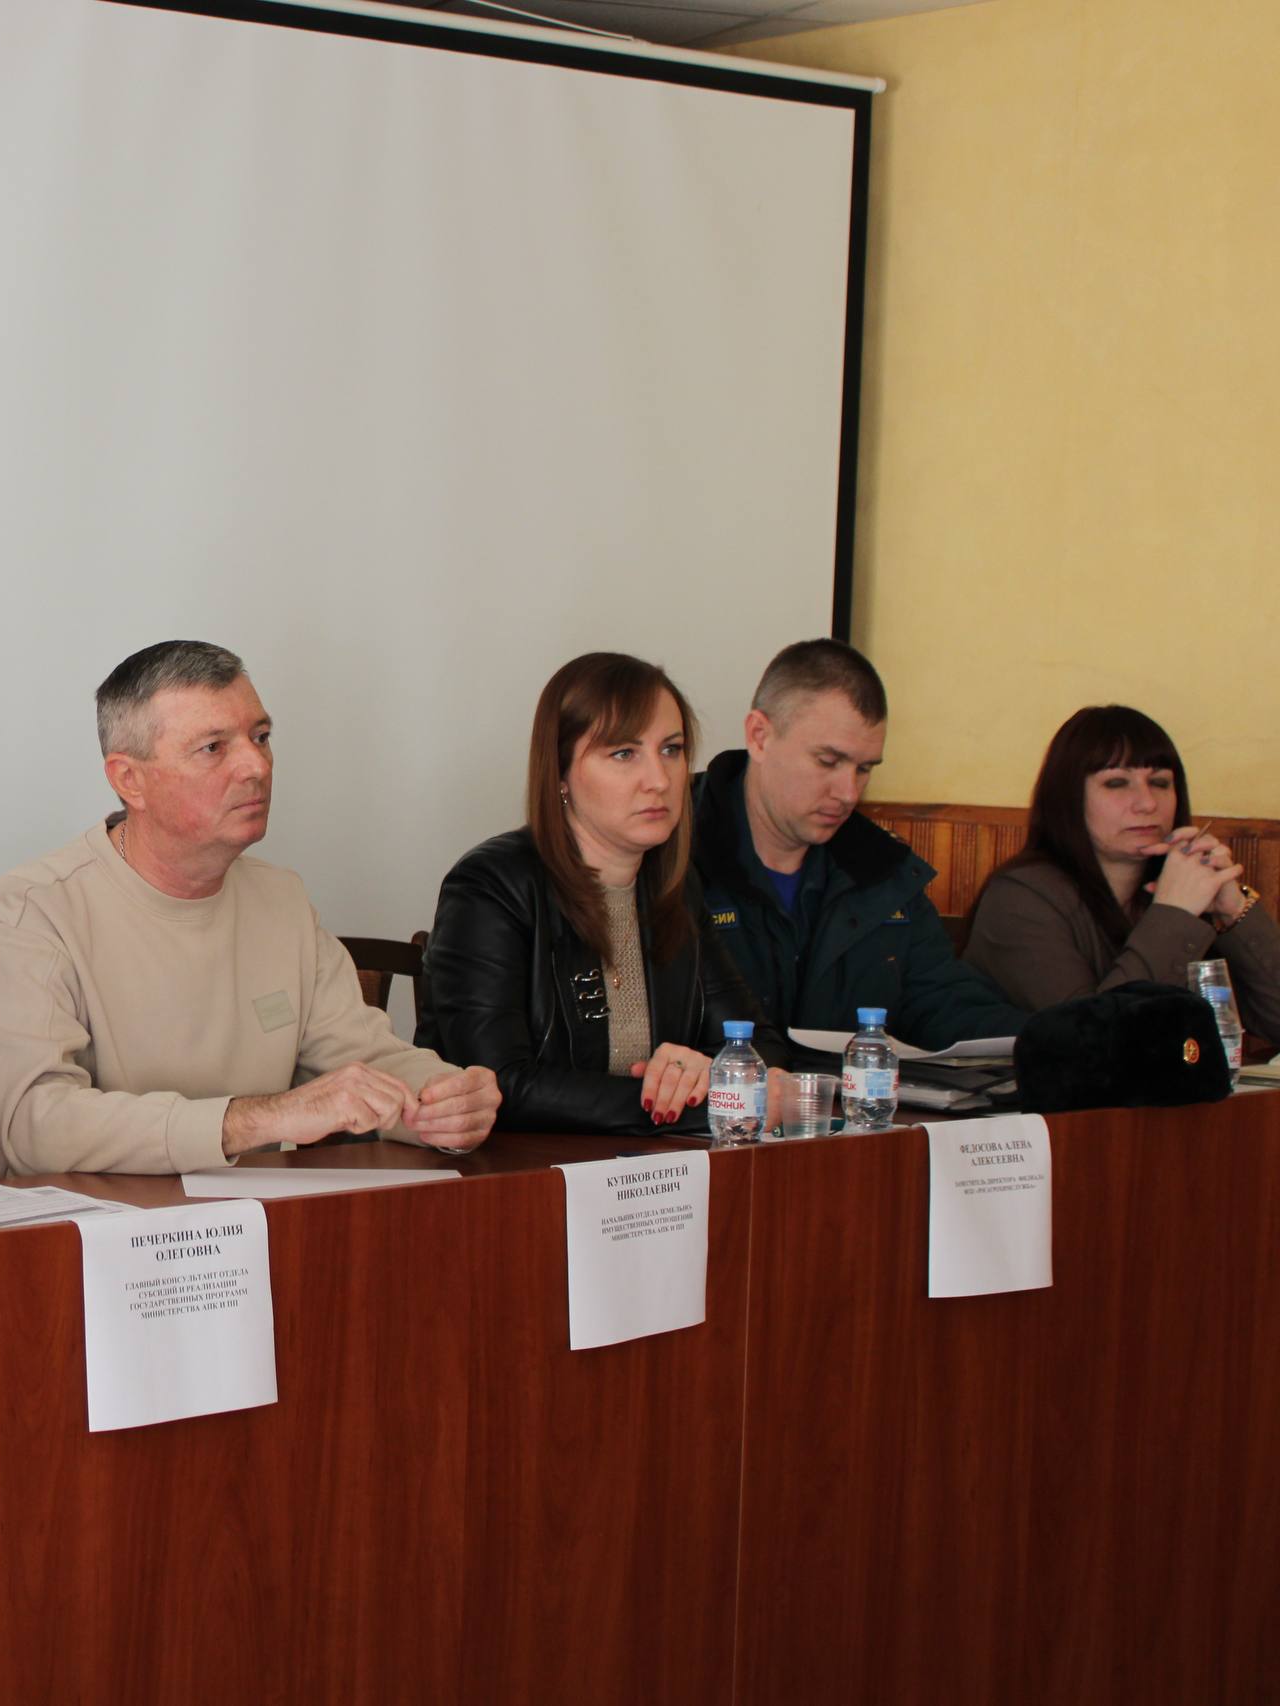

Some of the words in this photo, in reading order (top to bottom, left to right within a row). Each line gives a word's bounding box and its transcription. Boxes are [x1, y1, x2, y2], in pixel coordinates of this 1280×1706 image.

[607, 1171, 651, 1187] КУТИКОВ
[652, 1164, 689, 1180] СЕРГЕЙ
[617, 1181, 681, 1201] НИКОЛАЕВИЧ
[131, 1230, 203, 1248] ПЕЧЕРКИНА
[206, 1224, 244, 1239] ЮЛИЯ
[156, 1245, 221, 1262] ОЛЕГОВНА
[125, 1277, 161, 1292] ГЛАВНЫЙ
[162, 1271, 219, 1286] КОНСУЛЬТАНТ
[219, 1268, 249, 1279] ОТДЕЛА
[138, 1285, 178, 1300] СУБСИДИЙ
[186, 1279, 237, 1293] РЕАЛИЗАЦИИ
[129, 1294, 204, 1312] ГОСУДАРСТВЕННЫХ
[205, 1287, 249, 1301] ПРОГРАММ
[140, 1304, 201, 1320] МИНИСТЕРСТВА
